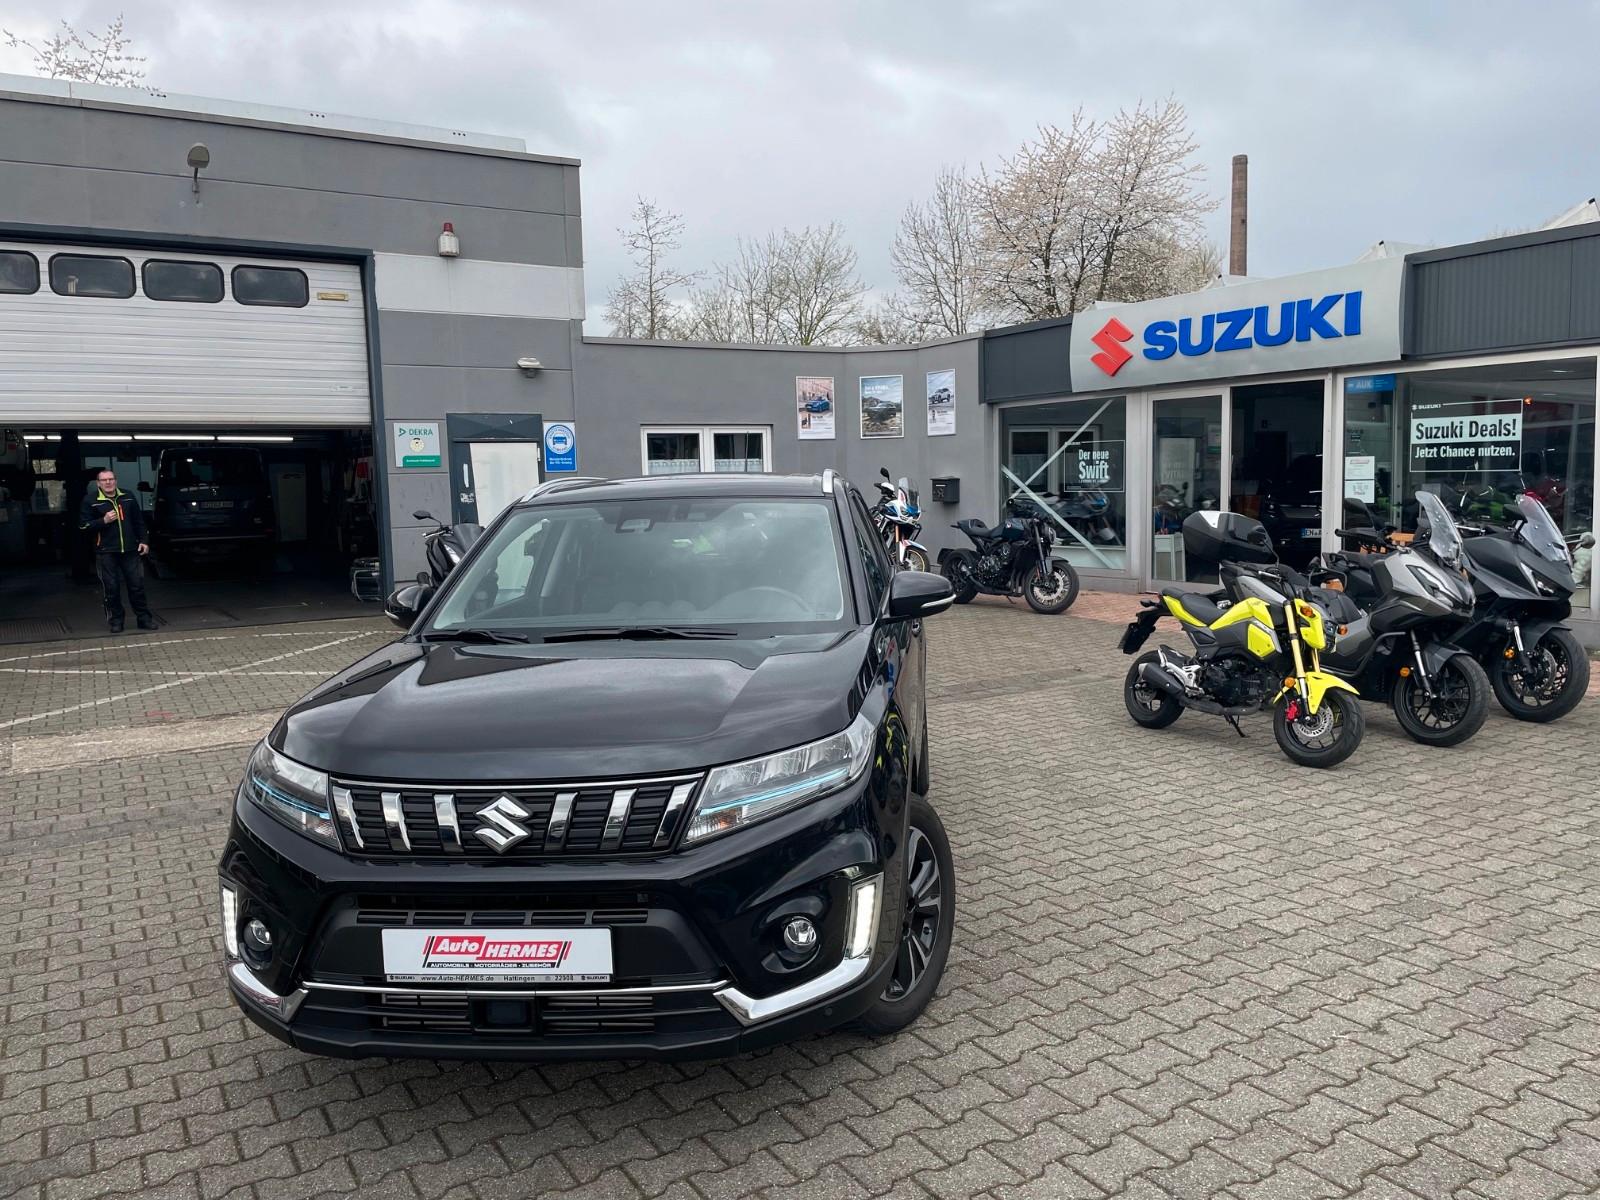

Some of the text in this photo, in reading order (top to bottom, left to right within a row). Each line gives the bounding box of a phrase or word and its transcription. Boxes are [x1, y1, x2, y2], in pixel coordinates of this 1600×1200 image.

[1143, 291, 1362, 360] SUZUKI
[409, 428, 433, 436] DEKRA
[1416, 419, 1516, 440] Suzuki Deals!
[1079, 449, 1109, 460] Der neue
[1415, 445, 1515, 458] Jetzt Chance nutzen.
[1079, 460, 1110, 479] Swift
[436, 939, 558, 958] Auto HERMES
